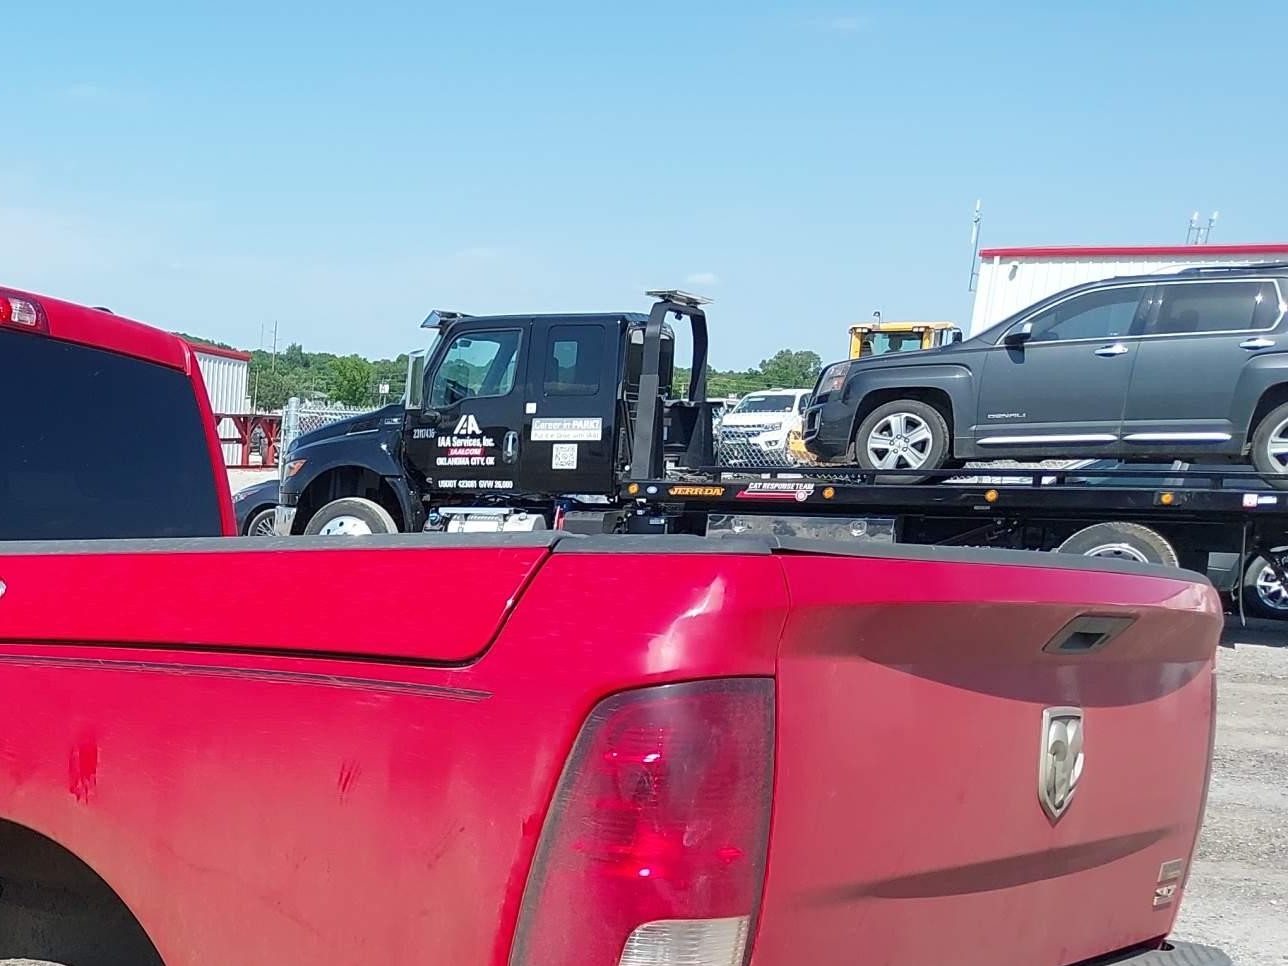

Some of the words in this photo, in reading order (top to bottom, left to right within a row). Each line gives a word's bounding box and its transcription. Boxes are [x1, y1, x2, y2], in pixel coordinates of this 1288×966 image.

[437, 436, 451, 447] IAA
[452, 436, 482, 447] Services,
[483, 436, 495, 447] Inc.
[436, 457, 470, 466] OKLAHOMA
[486, 457, 495, 465] OK
[438, 480, 457, 488] USDOT
[762, 482, 796, 490] RESPONSE
